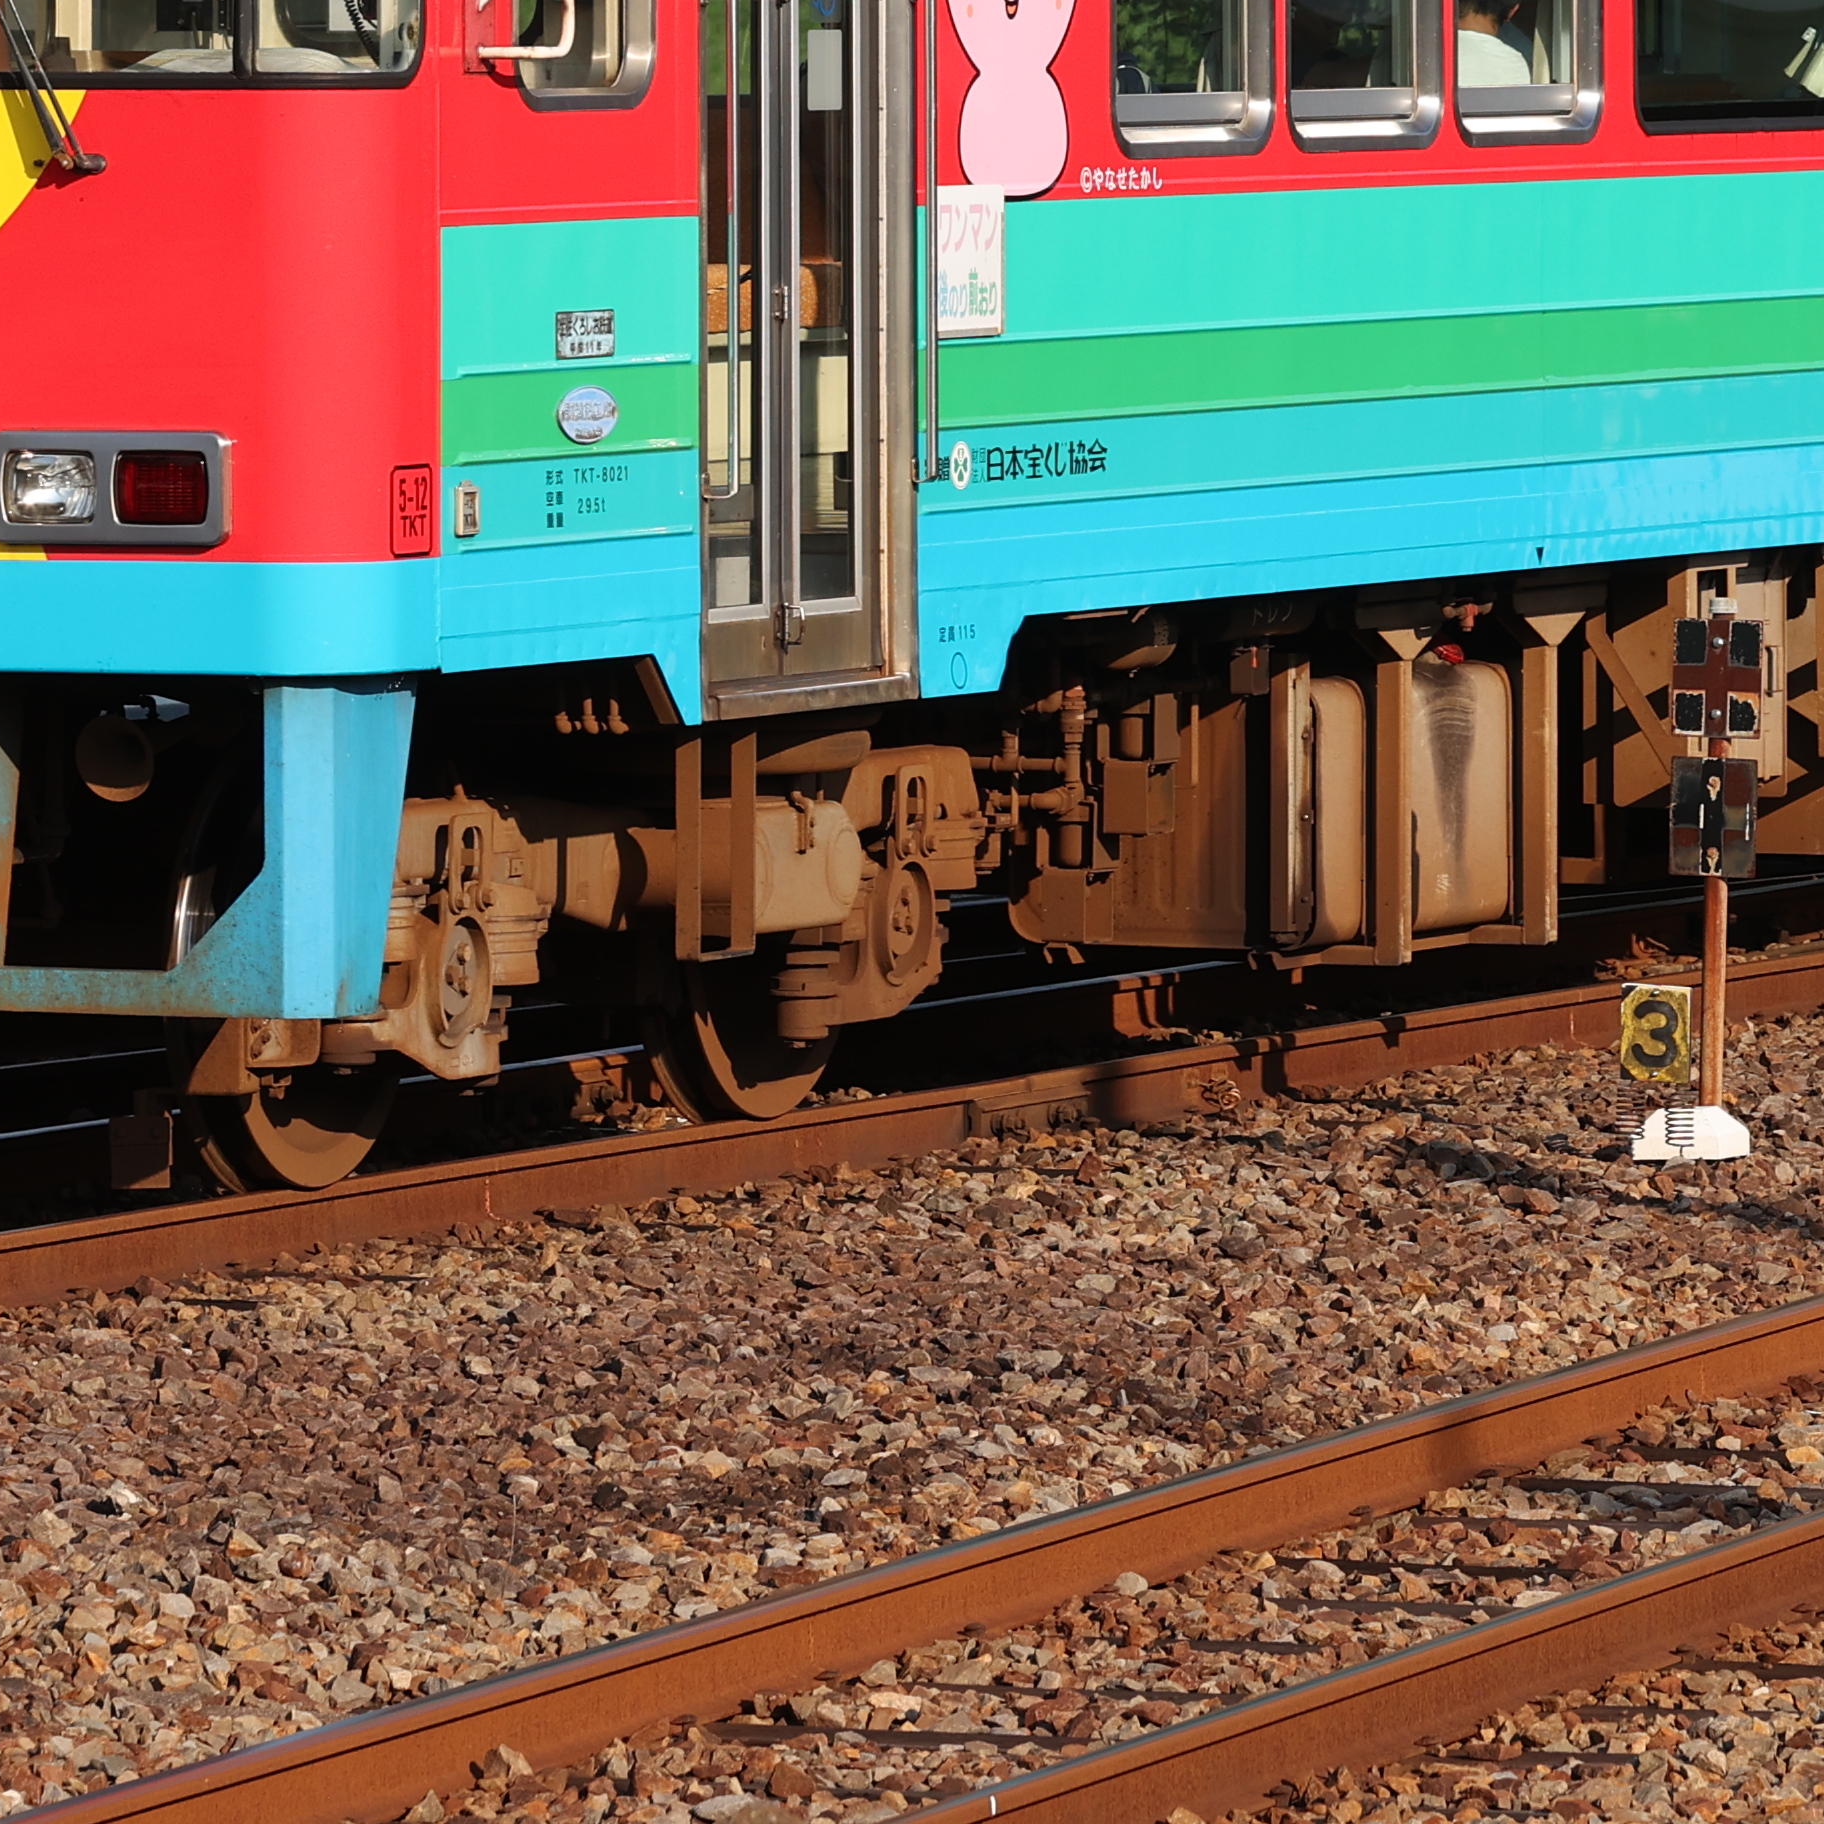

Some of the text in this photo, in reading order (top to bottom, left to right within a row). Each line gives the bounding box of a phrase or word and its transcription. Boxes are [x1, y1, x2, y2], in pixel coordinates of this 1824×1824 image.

[938, 203, 998, 254] ワンマン
[574, 465, 629, 485] TKT-8021
[987, 438, 1108, 482] 日本宝くじ協会
[398, 475, 428, 513] 5-12
[400, 514, 427, 538] TKT
[1630, 1000, 1679, 1069] 3
